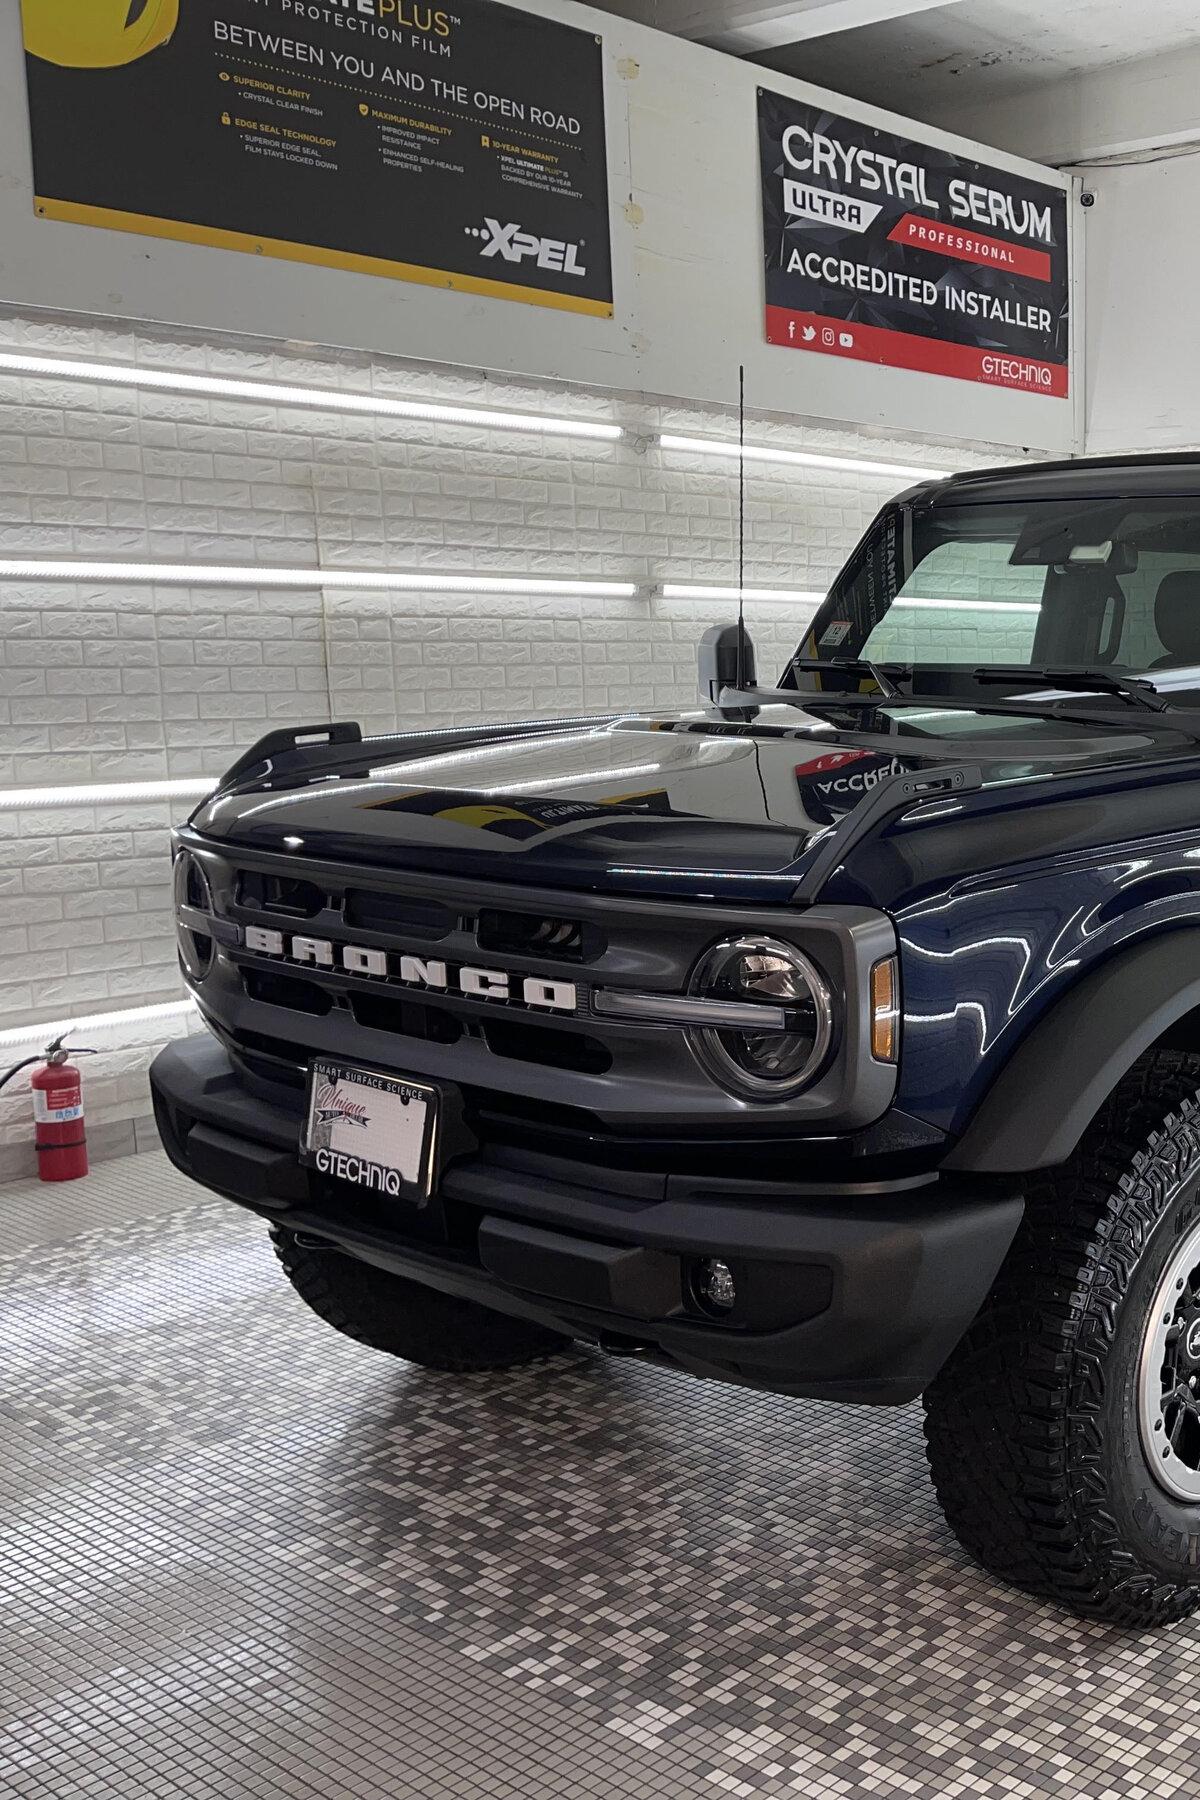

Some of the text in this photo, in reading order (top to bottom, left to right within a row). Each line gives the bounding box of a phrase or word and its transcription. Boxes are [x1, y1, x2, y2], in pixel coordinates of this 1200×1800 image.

[282, 0, 451, 57] PROTECTION FILM
[213, 21, 581, 135] BETWEEN YOU AND THE OPEN ROAD
[233, 75, 311, 100] SUPERIOR CLARITY
[243, 92, 323, 116] CRYSTAL CLEAR FINISH
[235, 118, 337, 148] EDGE SEAL TECHNOLOGY
[371, 109, 452, 136] MAXIMUM DURABILITY
[381, 125, 415, 139] IMPROVED
[244, 134, 280, 148] SUPERIOR
[281, 142, 301, 153] EDGE
[245, 144, 338, 170] FILM STAYS LOCKED DOWN
[382, 148, 418, 162] ENHANCED
[492, 140, 559, 163] 10-YEAR WARRANTY
[516, 158, 544, 172] ULTIMATE
[781, 124, 1051, 243] CRYSTAL SERUM
[792, 186, 862, 226] ULTRA
[479, 216, 586, 277] XPEL
[908, 223, 1015, 264] PROFESSIONAL
[786, 248, 1051, 332] ACCREDITED INSTALLER
[982, 355, 1052, 386] GTECHNIQ
[245, 925, 578, 1011] BRONCO
[313, 1063, 423, 1100] SMART SURFACE SCIENCE
[316, 1148, 401, 1196] GTECHNIQ
